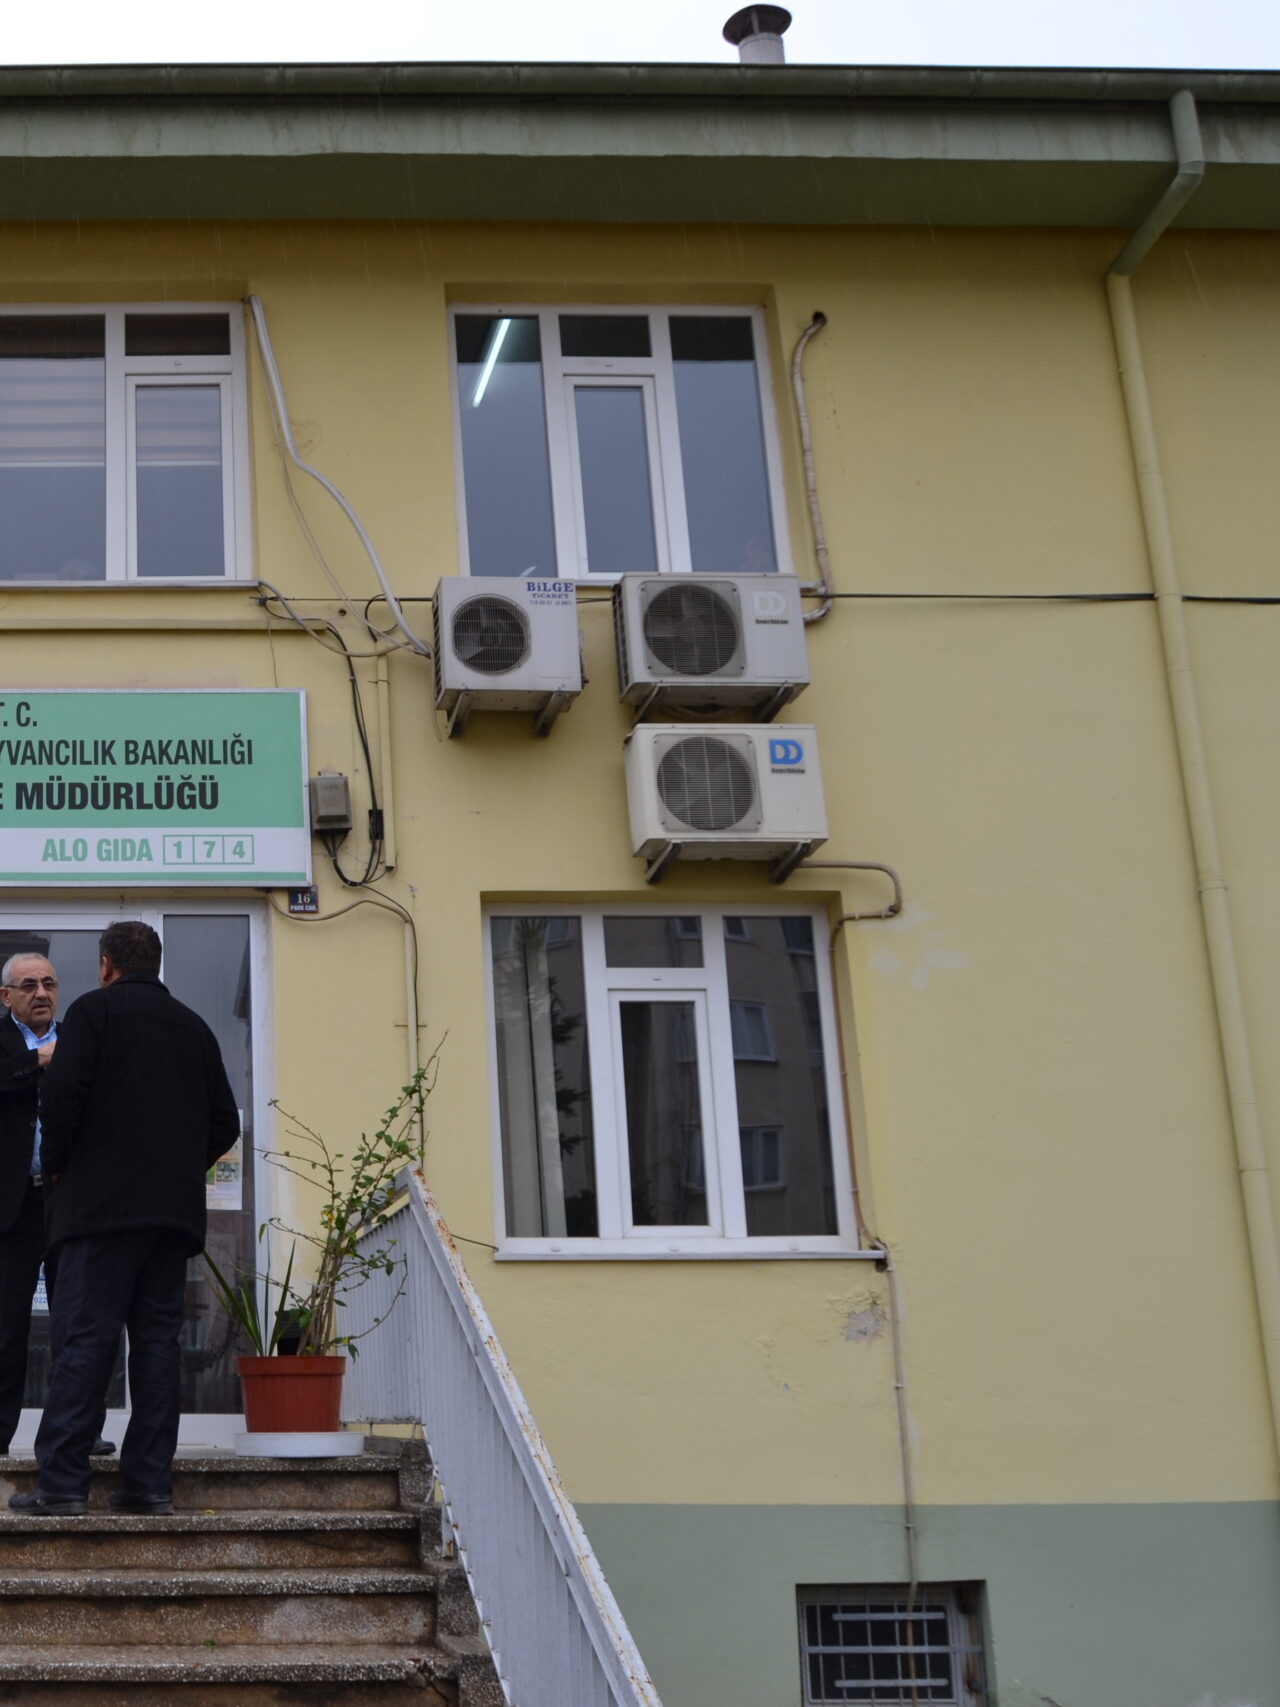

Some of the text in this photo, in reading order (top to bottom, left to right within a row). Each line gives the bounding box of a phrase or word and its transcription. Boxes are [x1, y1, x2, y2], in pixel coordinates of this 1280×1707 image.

[16, 701, 38, 727] C.
[124, 733, 253, 765] BAKANLIĞI
[15, 775, 219, 810] MÜDÜRLÜĞÜ
[42, 838, 89, 862] ALO
[96, 838, 153, 862] GIDA
[297, 893, 311, 904] 16
